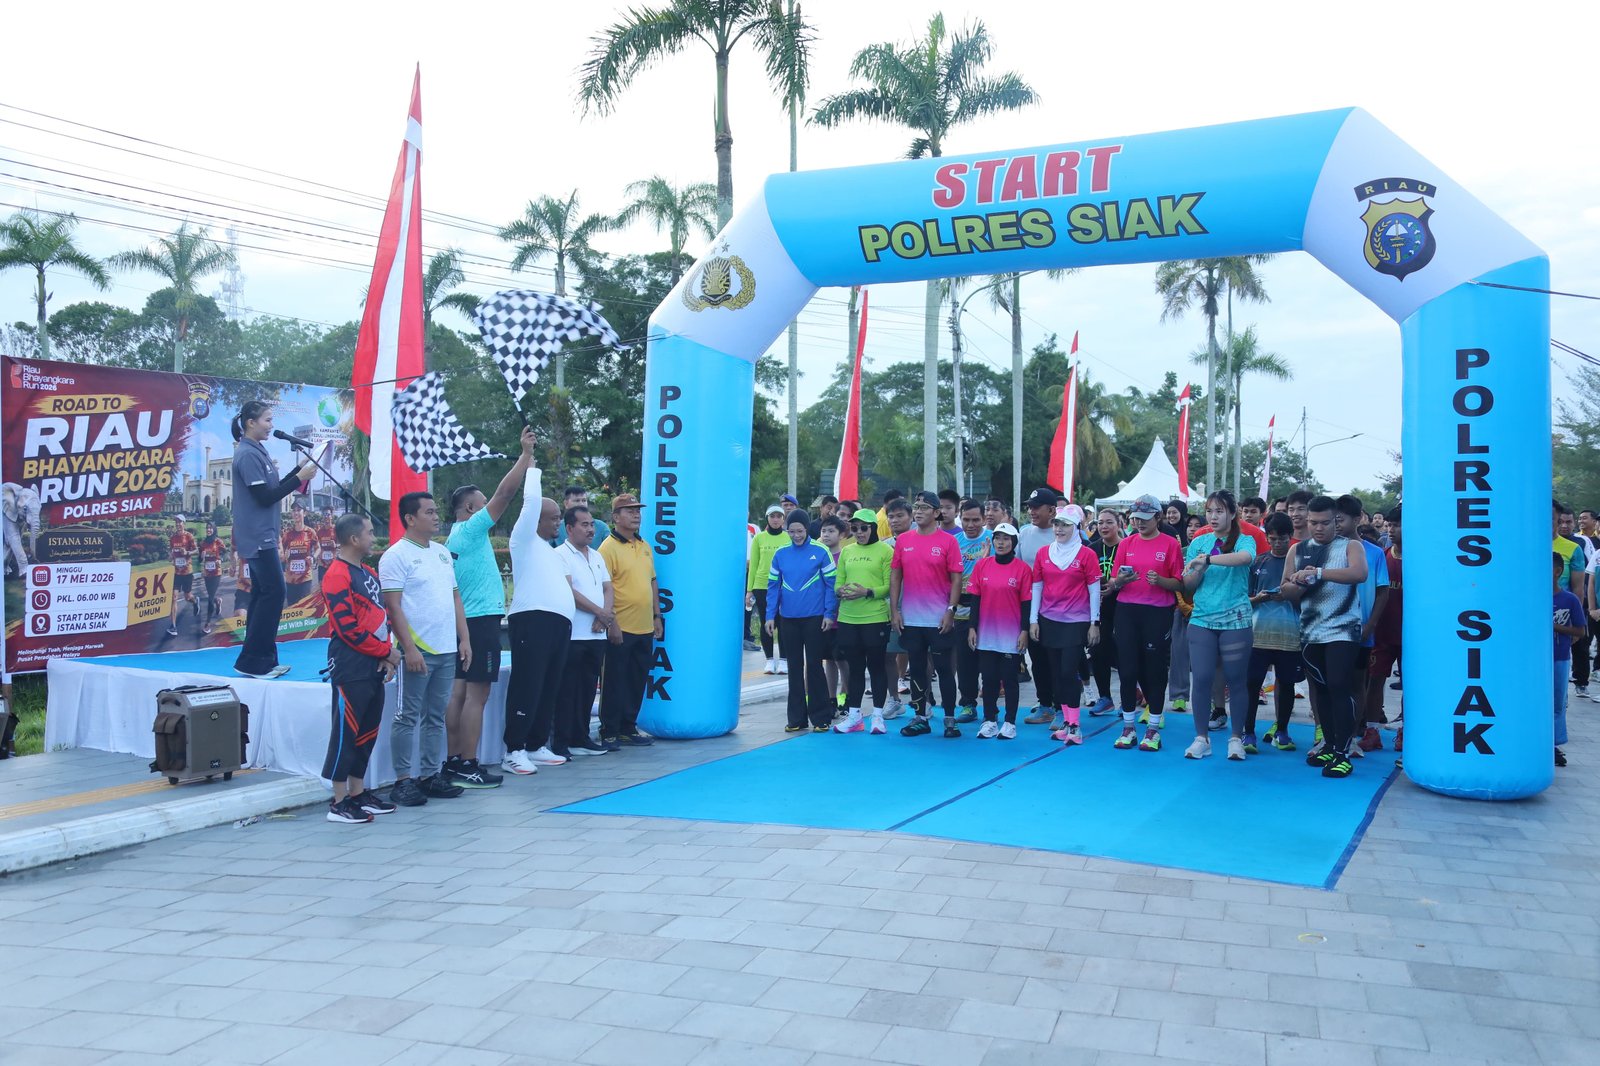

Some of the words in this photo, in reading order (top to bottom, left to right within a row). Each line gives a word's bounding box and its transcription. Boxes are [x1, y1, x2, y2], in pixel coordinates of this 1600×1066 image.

[932, 144, 1124, 210] START
[1364, 182, 1427, 194] RIAU
[858, 207, 1056, 263] POLRES
[1067, 191, 1211, 245] SIAK
[23, 365, 40, 374] Riau
[23, 374, 74, 385] Bhayangkara
[52, 399, 98, 412] ROAD
[102, 397, 122, 410] TO
[24, 410, 174, 458] RIAU
[23, 448, 175, 479] BHAYANGKARA
[1452, 348, 1494, 567] POLRES
[653, 385, 683, 555] POLRES
[40, 472, 110, 504] RUN
[114, 466, 172, 494] 2026
[64, 501, 118, 520] POLRES
[121, 496, 153, 512] SIAK
[48, 538, 81, 546] ISTANA
[84, 536, 104, 545] SIAK
[56, 576, 68, 584] 17
[70, 574, 88, 584] MEI
[91, 573, 114, 582] 2026
[134, 577, 148, 599] 8
[152, 572, 168, 596] K
[56, 595, 75, 603] PKL.
[76, 594, 98, 602] 06.00
[100, 592, 116, 601] WIB
[134, 596, 166, 610] KATEGORI
[57, 614, 82, 622] START
[84, 612, 110, 620] DEPAN
[139, 608, 160, 618] UMUM
[57, 622, 86, 632] ISTANA
[88, 621, 108, 630] SIAK
[288, 620, 302, 628] With
[17, 648, 47, 656] Melindungi
[1453, 610, 1496, 755] SIAK
